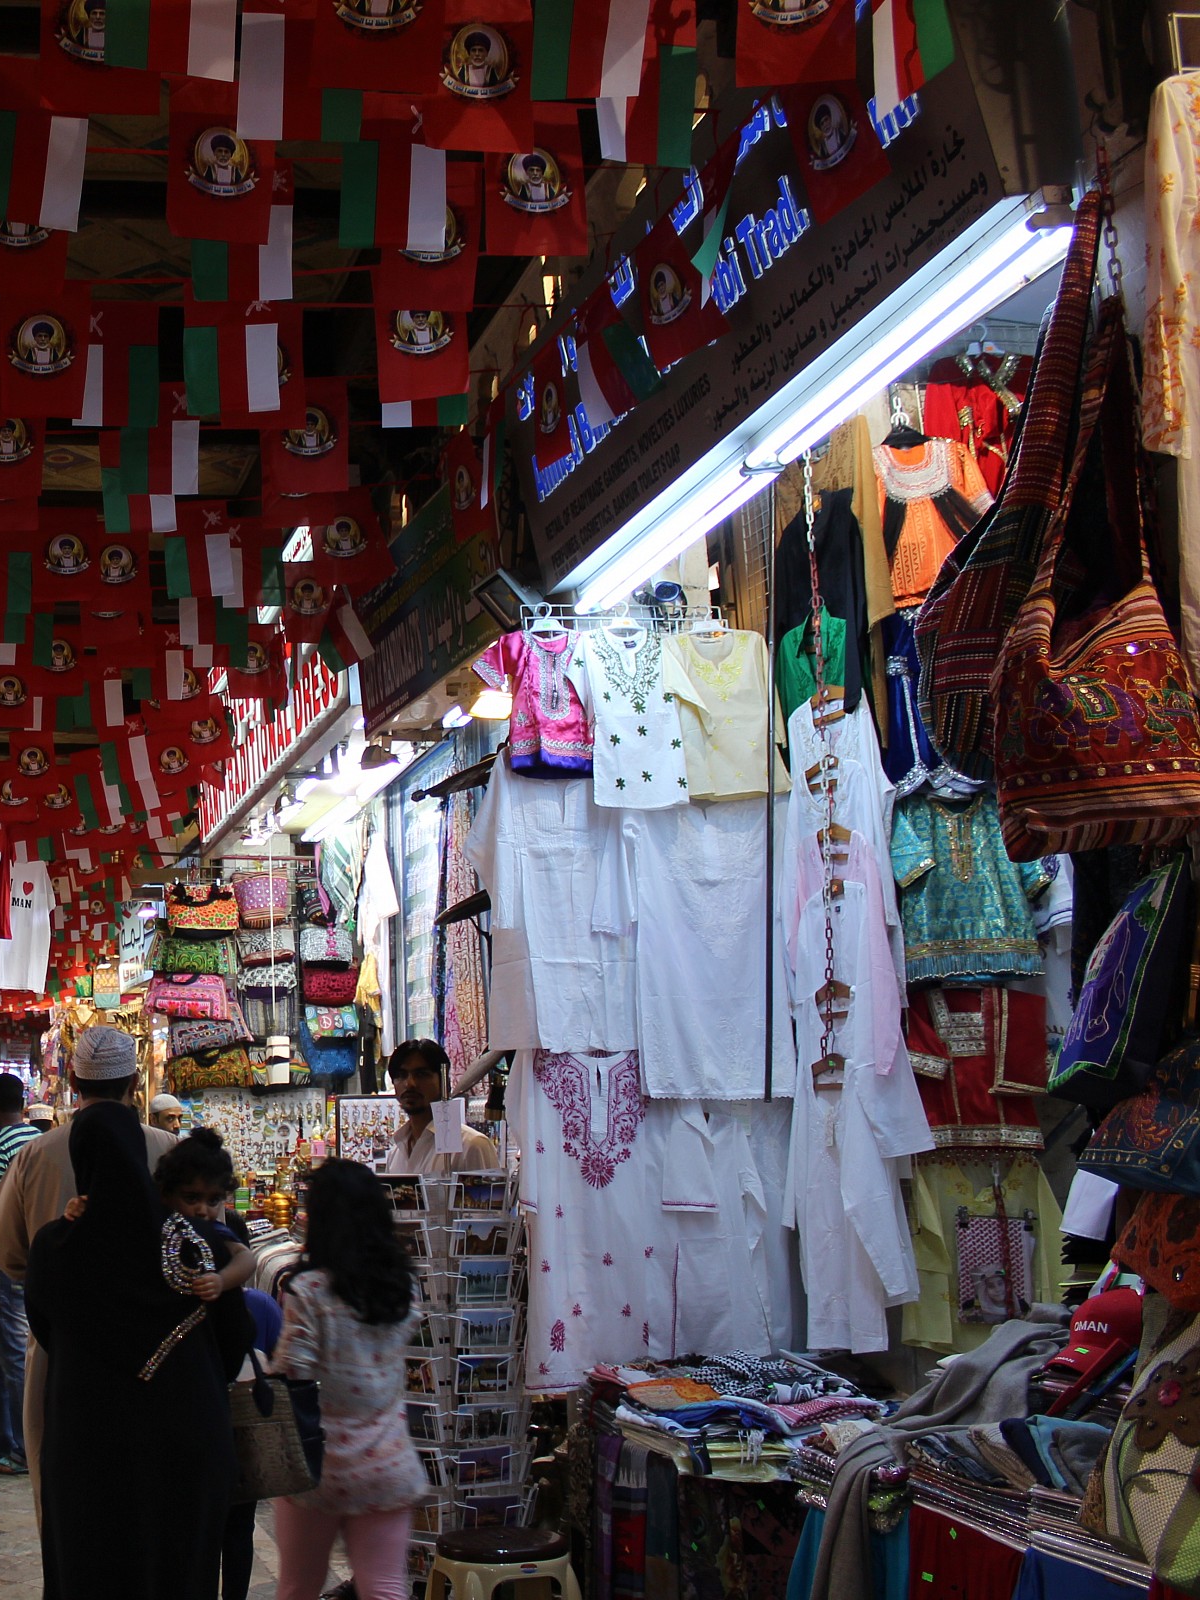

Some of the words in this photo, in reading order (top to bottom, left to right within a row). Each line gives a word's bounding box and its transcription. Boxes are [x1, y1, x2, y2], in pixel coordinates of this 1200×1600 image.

[735, 174, 811, 279] Trad.
[883, 164, 928, 234] الملابس
[835, 213, 877, 273] الجاهزة
[731, 322, 772, 376] والعطور
[569, 475, 605, 519] READYMADE
[636, 407, 676, 455] NOVELTIES
[673, 372, 712, 421] LUXURIES
[293, 650, 340, 738] DRESS
[11, 896, 32, 909] MAN
[1074, 1320, 1108, 1334] OMAN
